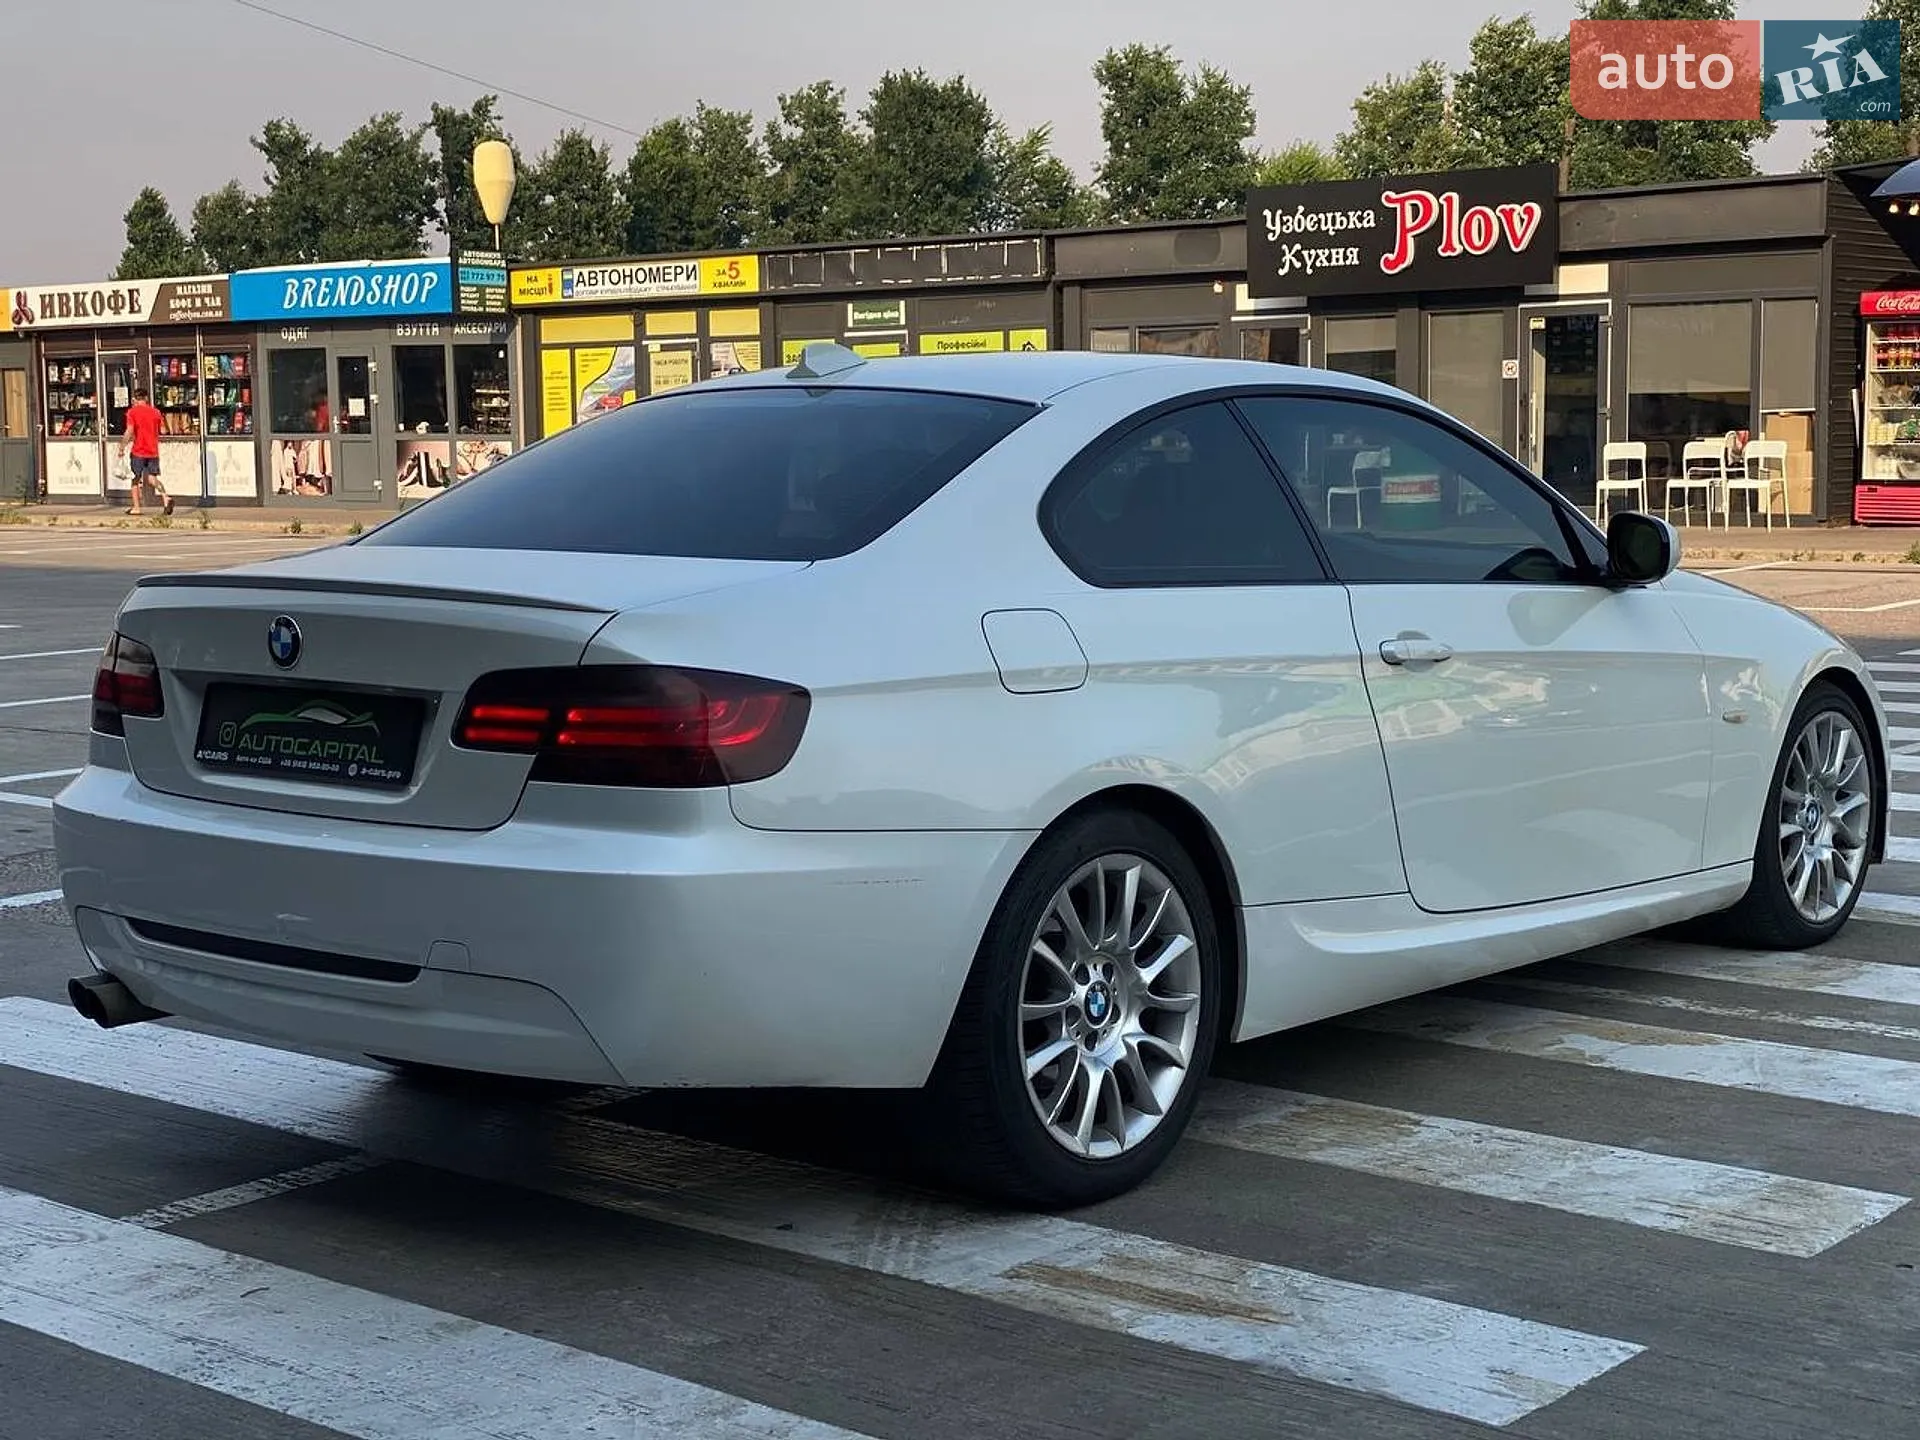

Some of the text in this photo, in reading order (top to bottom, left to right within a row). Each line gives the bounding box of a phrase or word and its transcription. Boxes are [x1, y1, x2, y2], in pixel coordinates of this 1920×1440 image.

[1263, 205, 1376, 241] Узбецька
[1380, 190, 1542, 274] Plov
[1278, 244, 1360, 276] Кухня
[575, 265, 698, 287] АВТОНОМЕРИ
[715, 261, 740, 279] ЗА 5
[526, 275, 539, 284] НА
[712, 280, 746, 289] ХВИЛИН
[283, 272, 439, 310] BRENDSHOP
[39, 288, 142, 320] ИВКОФЕ
[169, 298, 193, 309] КОФЕ
[195, 297, 202, 307] И
[281, 327, 310, 342] ОДЯГ
[397, 323, 440, 336] ВЗУТТЯ
[454, 322, 507, 335] АКСЕСУАРИ
[936, 340, 987, 351] Професійні
[239, 733, 384, 764] AUTOCAPITAL
